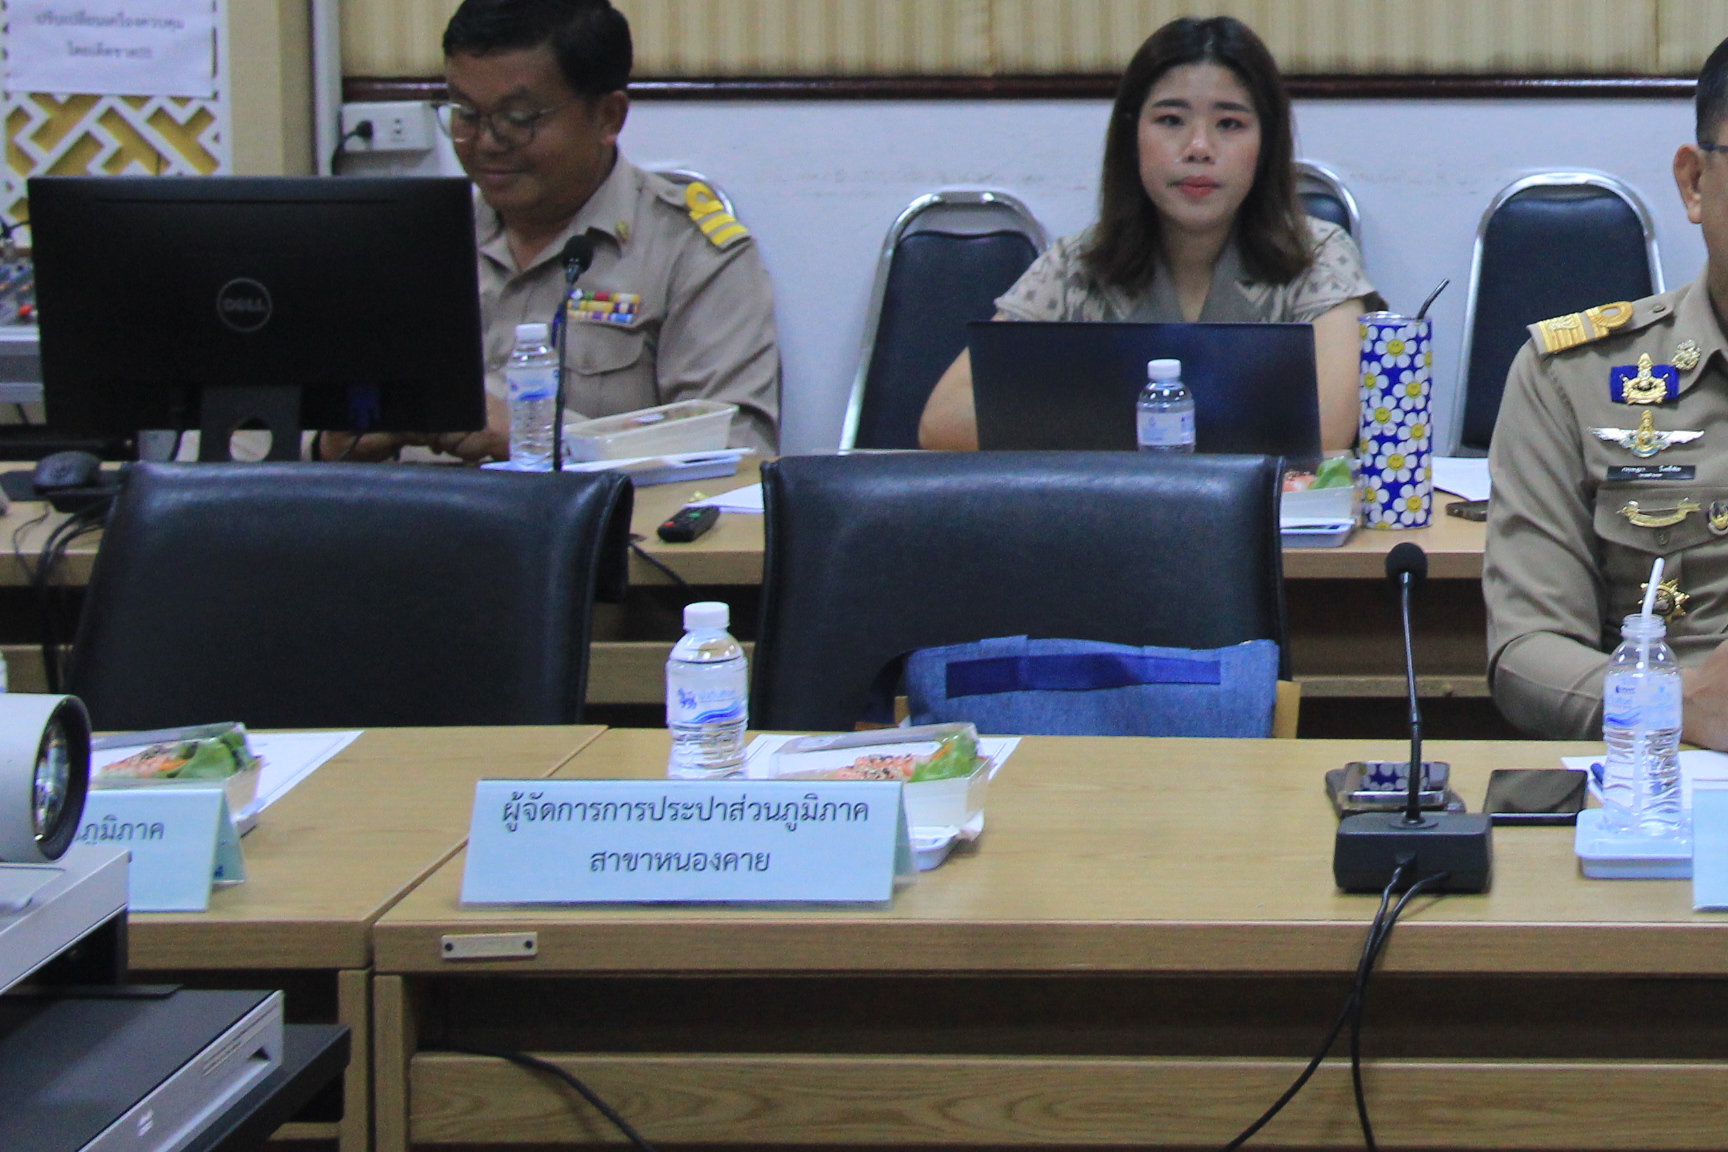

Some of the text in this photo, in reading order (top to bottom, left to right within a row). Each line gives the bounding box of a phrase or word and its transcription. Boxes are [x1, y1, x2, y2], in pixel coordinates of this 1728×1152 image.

[502, 791, 870, 833] ผู้จัดการการประปาส่วนภูมิภาค
[76, 814, 165, 846] ภูมิภาค
[589, 850, 771, 873] สาขาหนองคาย
